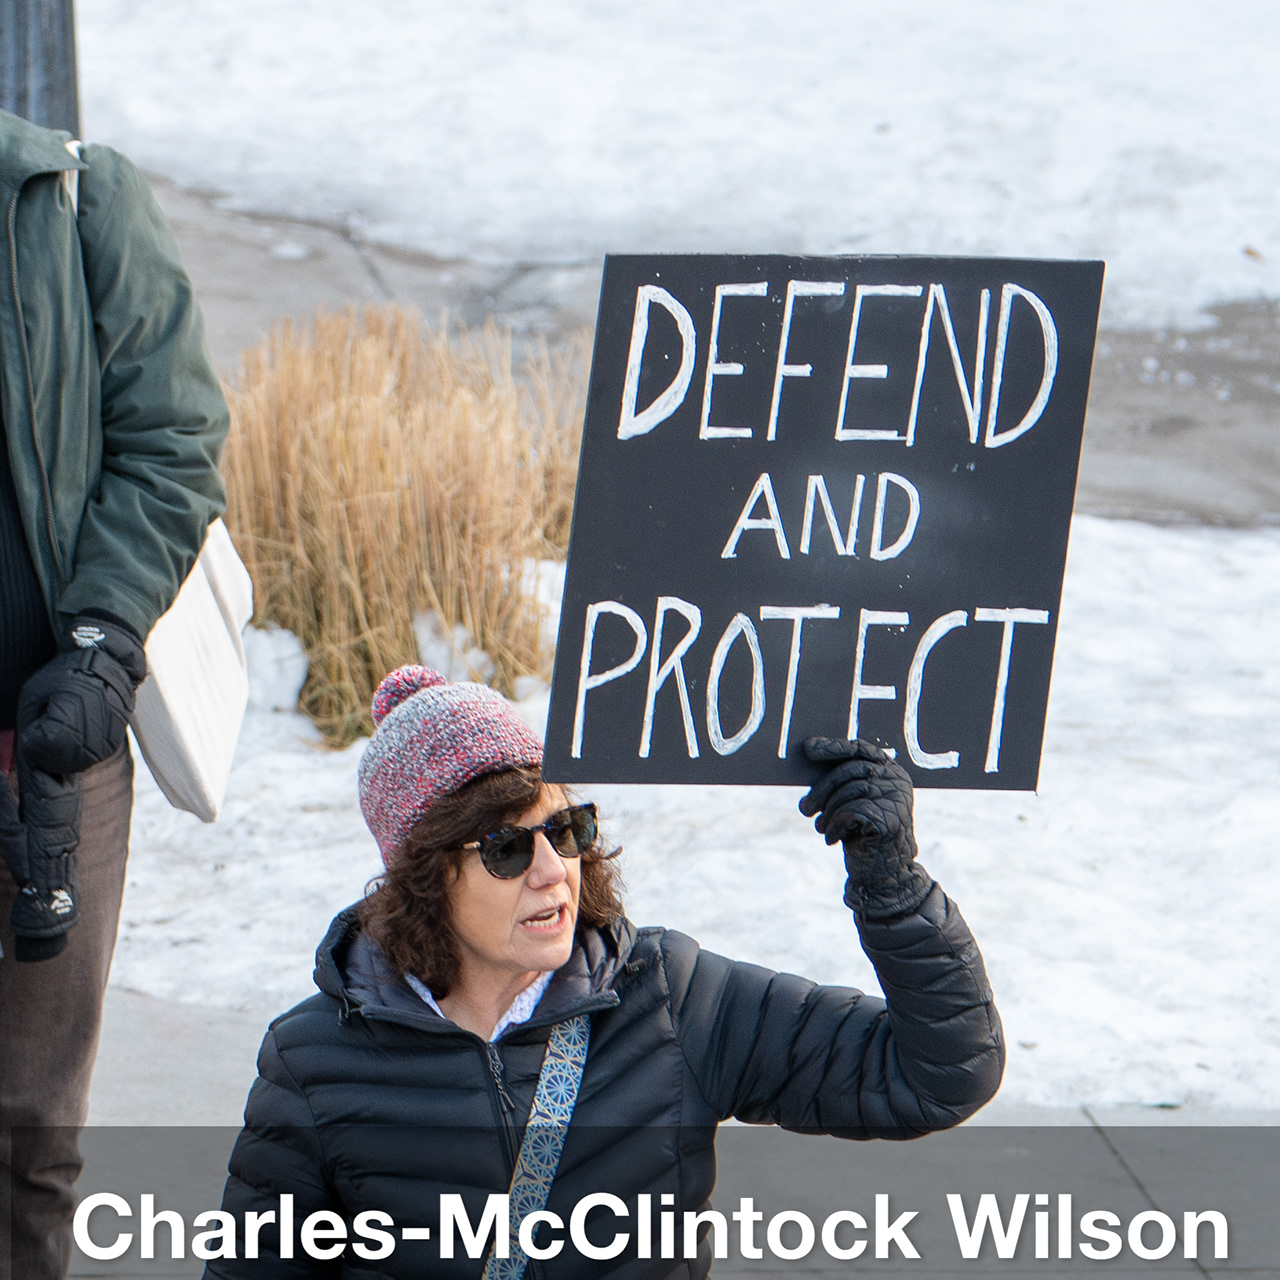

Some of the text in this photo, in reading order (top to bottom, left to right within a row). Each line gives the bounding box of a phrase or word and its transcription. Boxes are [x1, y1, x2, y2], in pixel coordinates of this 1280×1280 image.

[617, 279, 1058, 448] DEFEND
[721, 472, 921, 561] AND
[571, 596, 1049, 774] PROTECT
